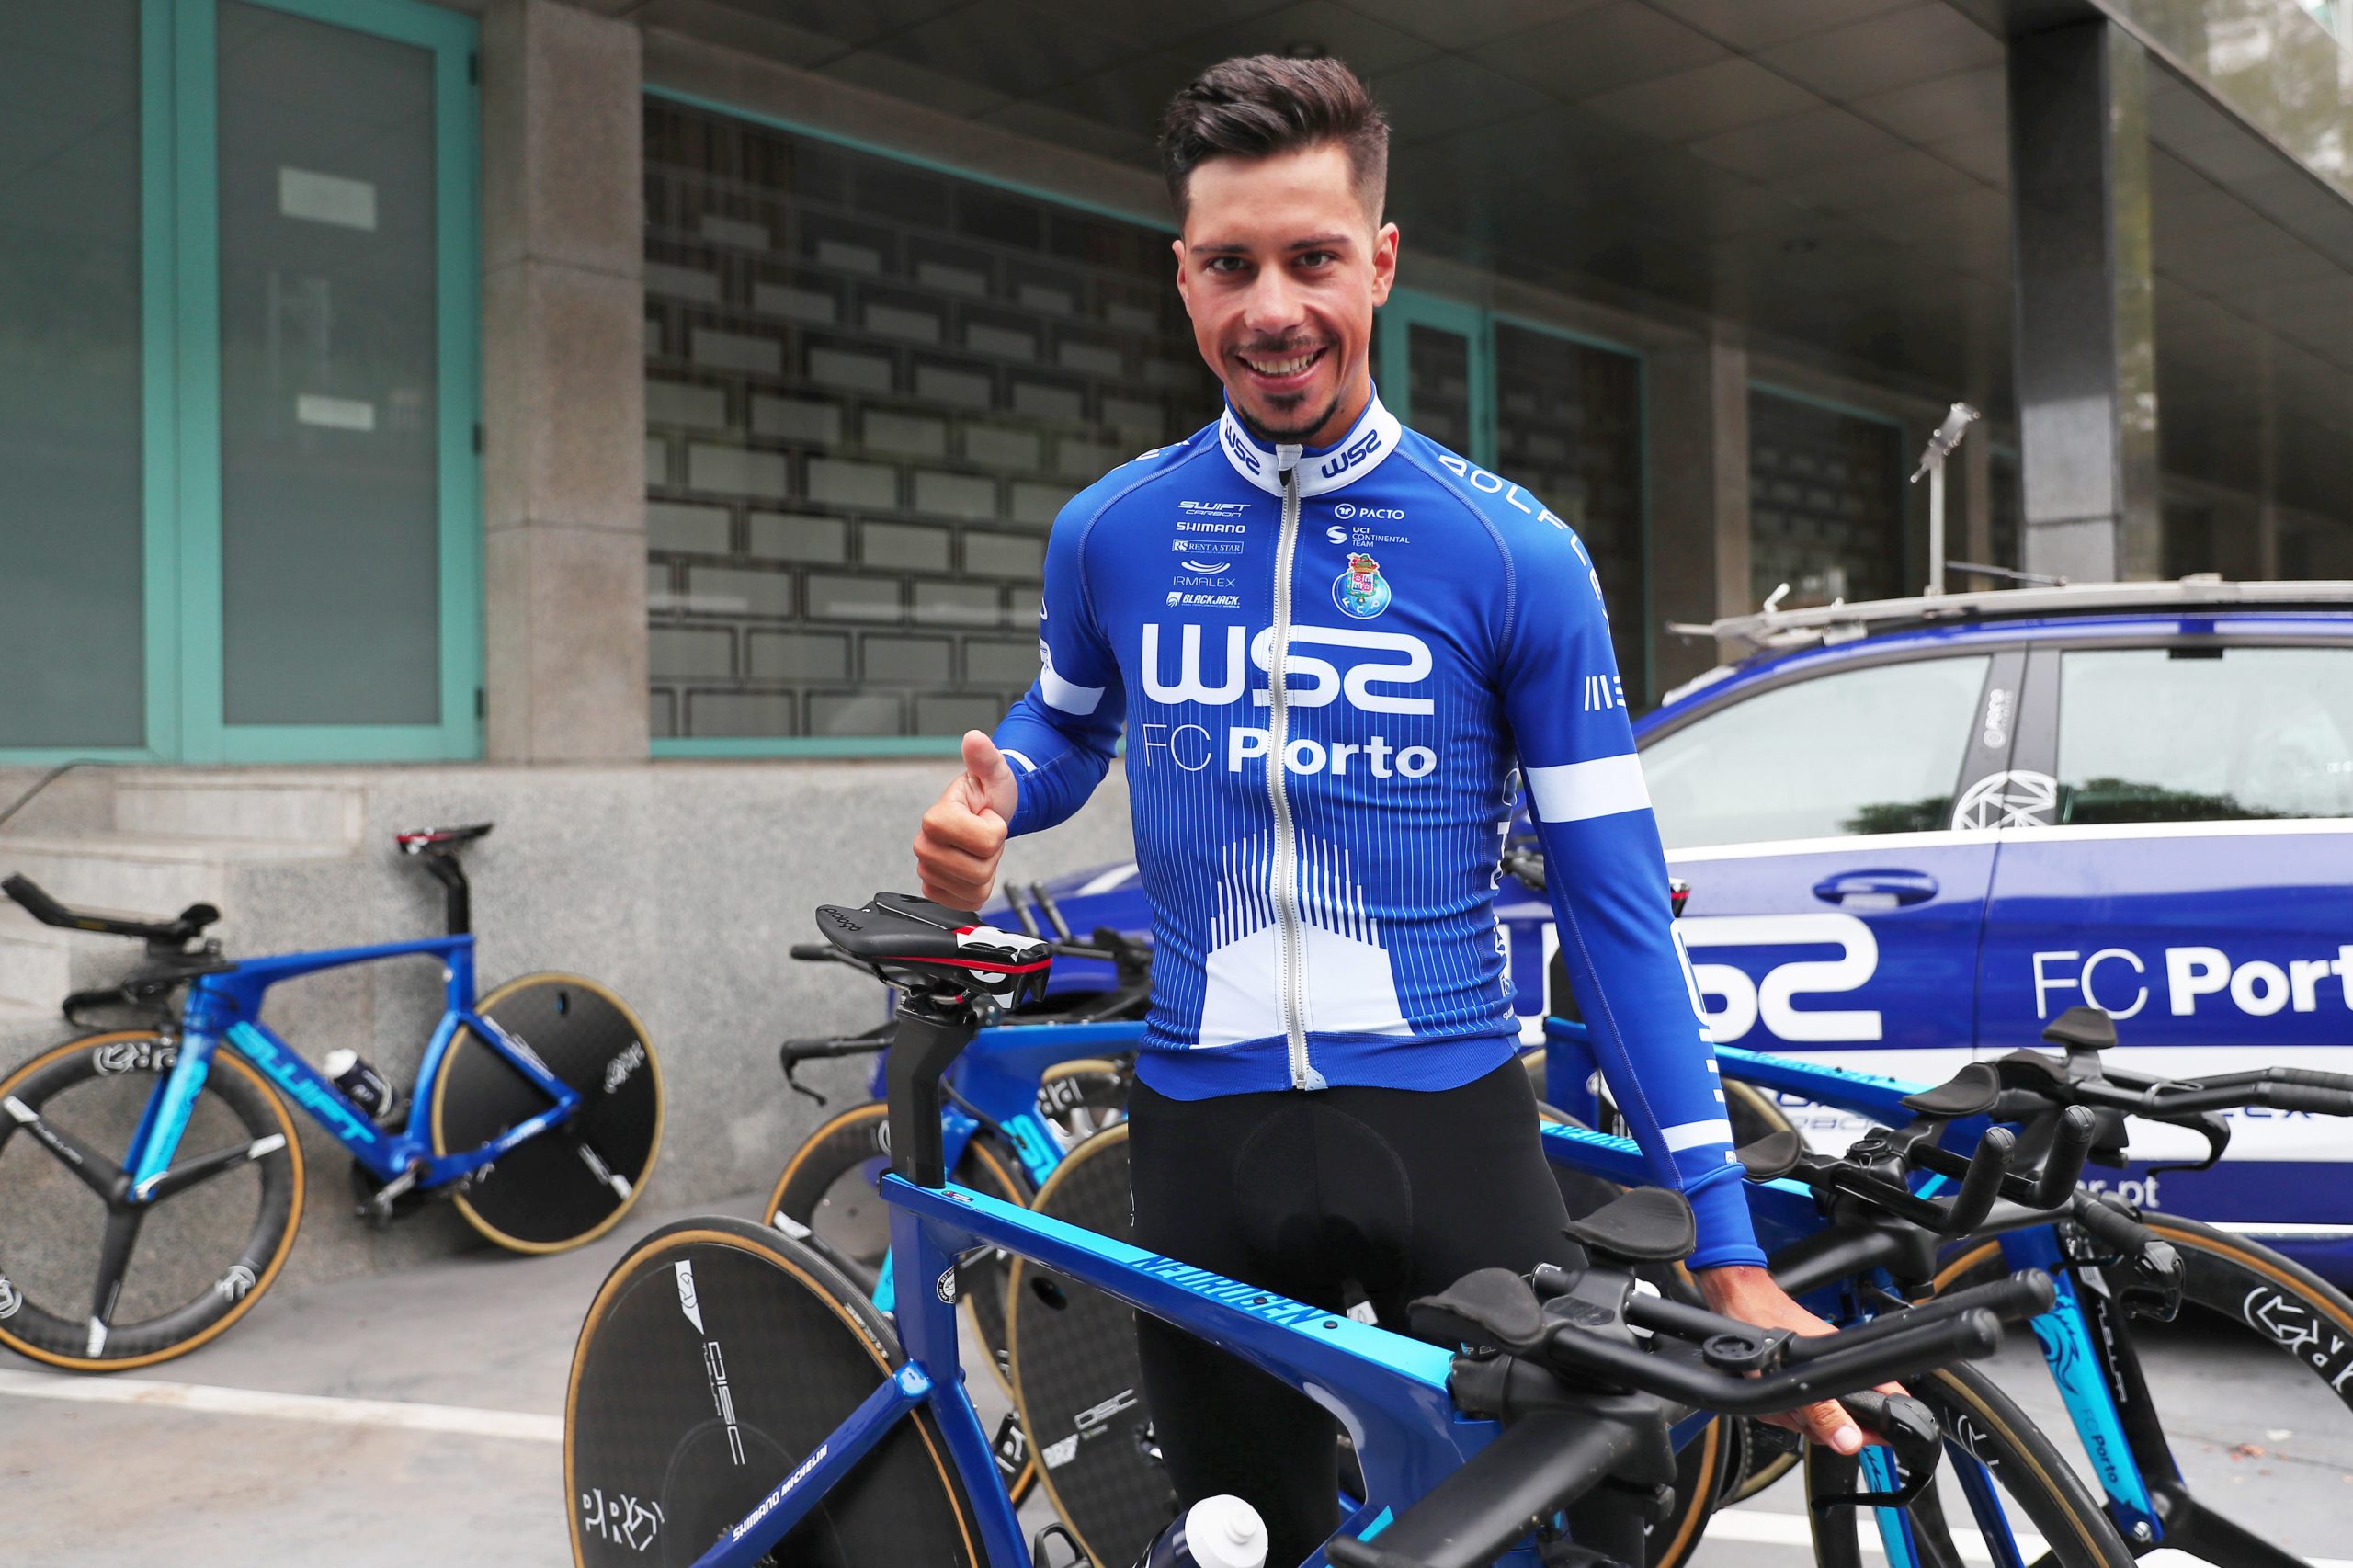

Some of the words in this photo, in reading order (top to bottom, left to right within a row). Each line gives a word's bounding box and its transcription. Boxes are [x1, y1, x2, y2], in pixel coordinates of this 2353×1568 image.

[1177, 500, 1252, 511] SWIFT
[1185, 509, 1242, 517] CARBON
[1359, 507, 1405, 520] PACTO
[1176, 521, 1246, 534] SHIMANO
[1352, 533, 1411, 544] CONTINENTAL
[1175, 540, 1188, 551] RS
[1173, 575, 1236, 588] IRMALEX
[1142, 722, 1212, 772] FC
[1228, 725, 1438, 778] Porto
[2031, 947, 2150, 1021] FC
[225, 1020, 376, 1144] SWIFT
[1130, 1255, 1332, 1325] NEUROGEN
[2090, 1435, 2120, 1483] Porto
[732, 1491, 780, 1543] SHIMANO
[780, 1444, 828, 1497] MICHELIN
